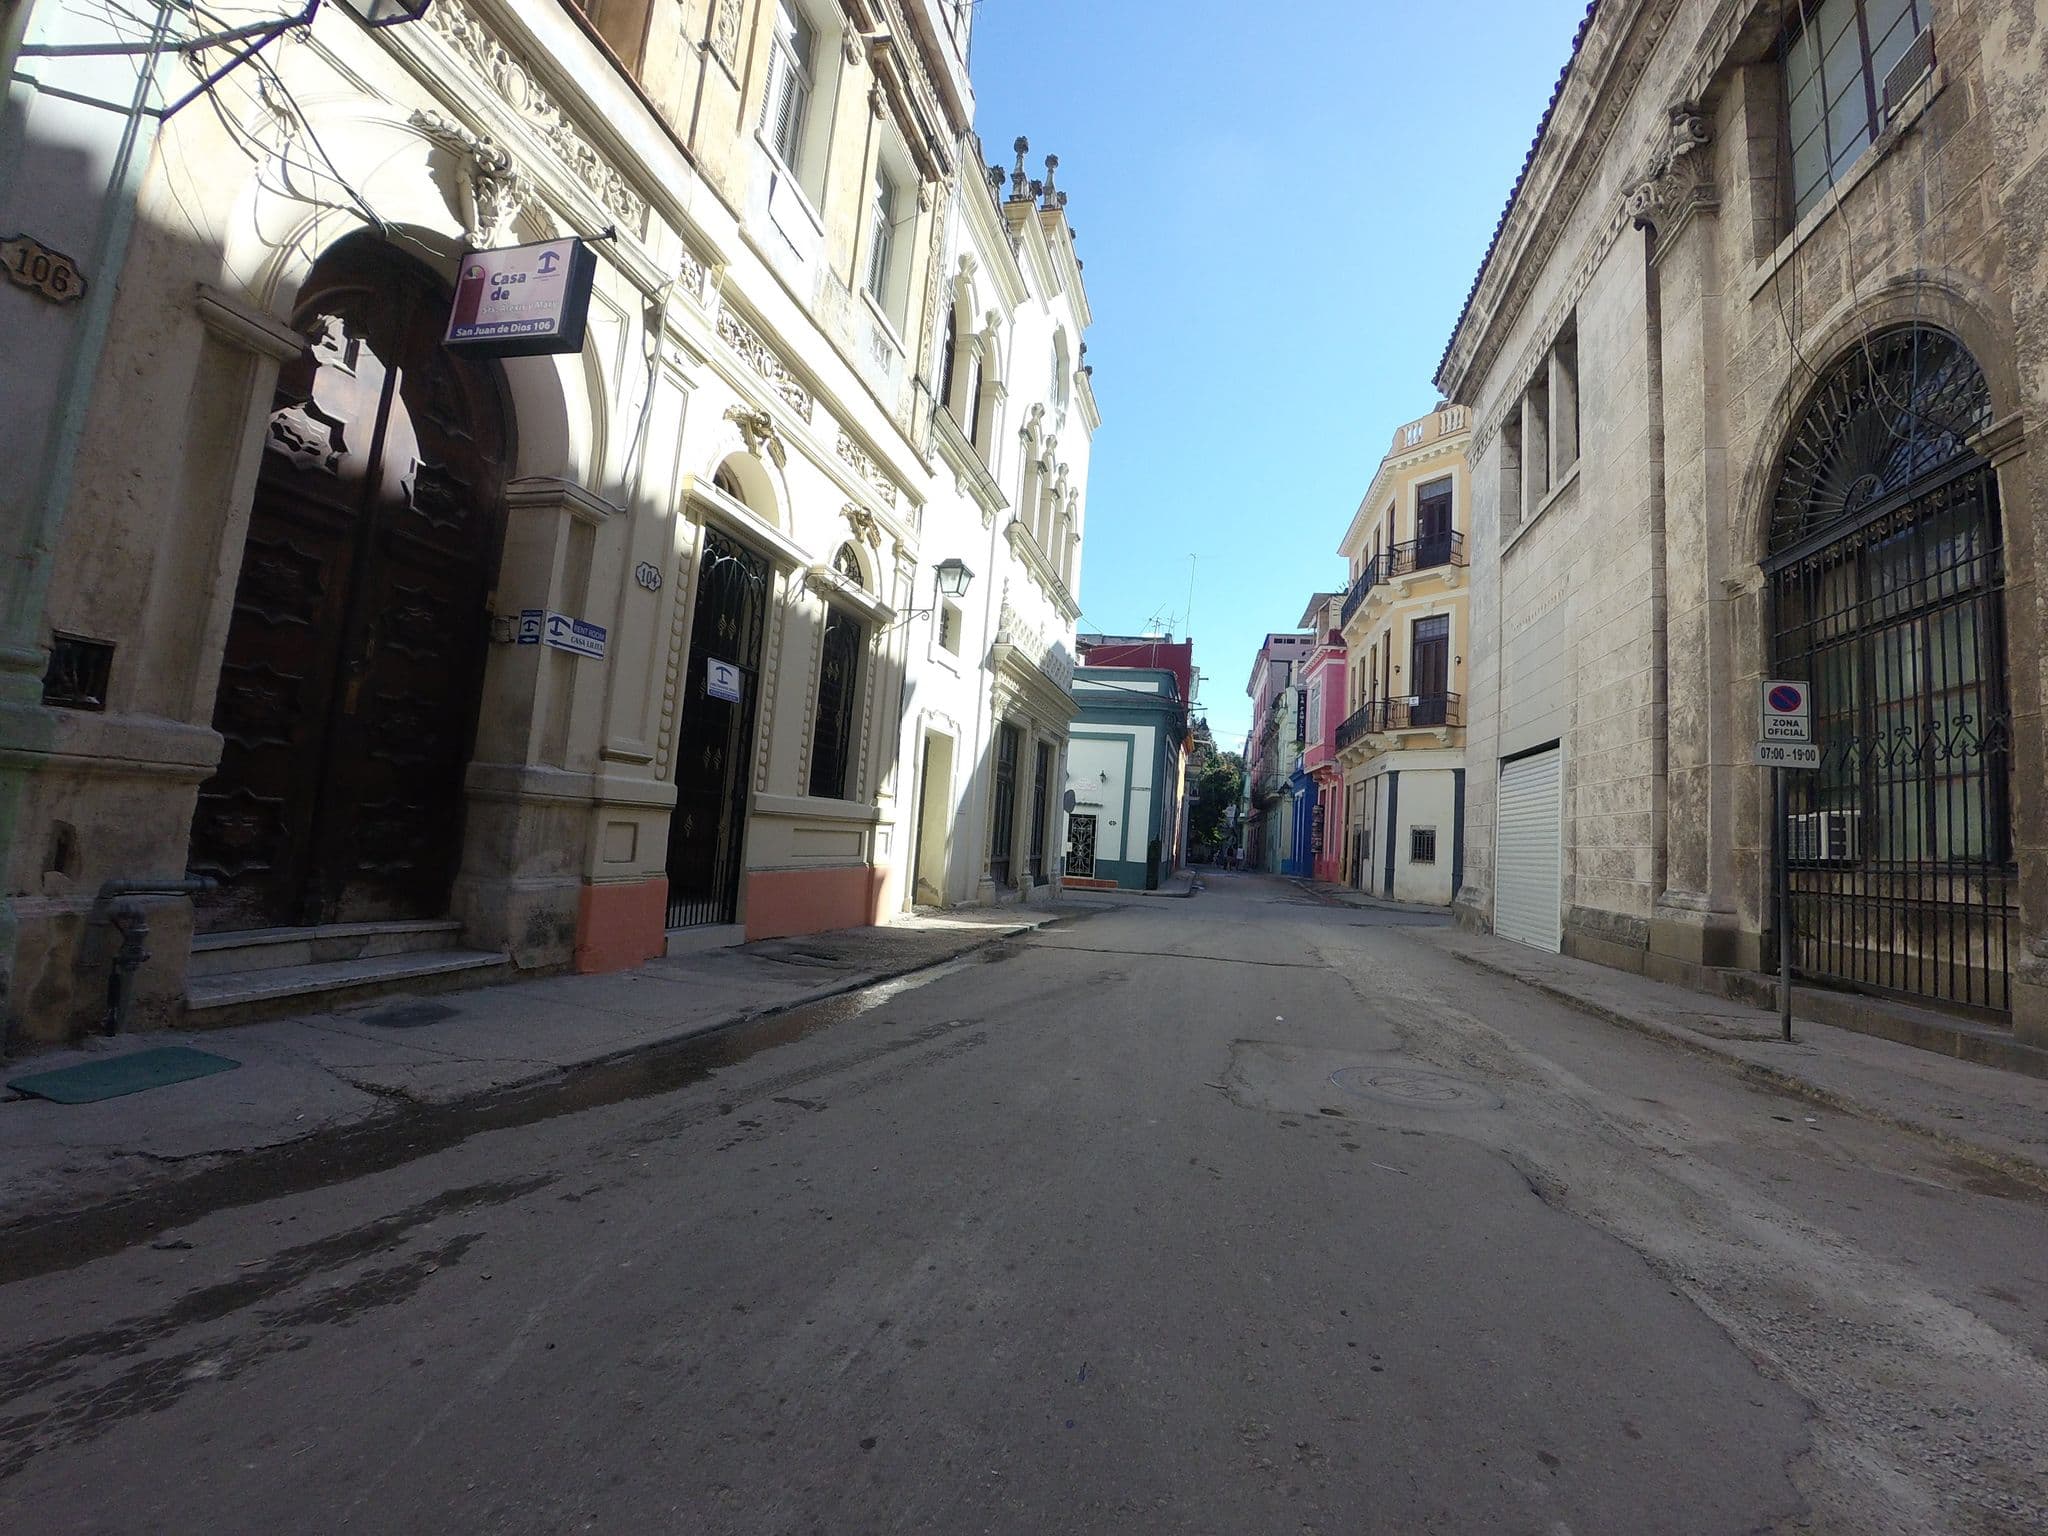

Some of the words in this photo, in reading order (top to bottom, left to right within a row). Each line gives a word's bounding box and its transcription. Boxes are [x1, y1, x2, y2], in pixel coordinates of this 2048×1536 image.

[15, 248, 70, 293] 106
[490, 272, 527, 286] Casa
[490, 287, 510, 301] de
[456, 328, 473, 337] San
[474, 326, 495, 336] Juan
[497, 324, 509, 334] de
[510, 323, 531, 332] Dios
[534, 321, 551, 331] 106
[641, 568, 658, 587] 104
[571, 636, 586, 647] CASA
[1773, 719, 1799, 727] ZONA
[1768, 728, 1805, 737] OFICIAL
[1761, 747, 1784, 760] 07:00
